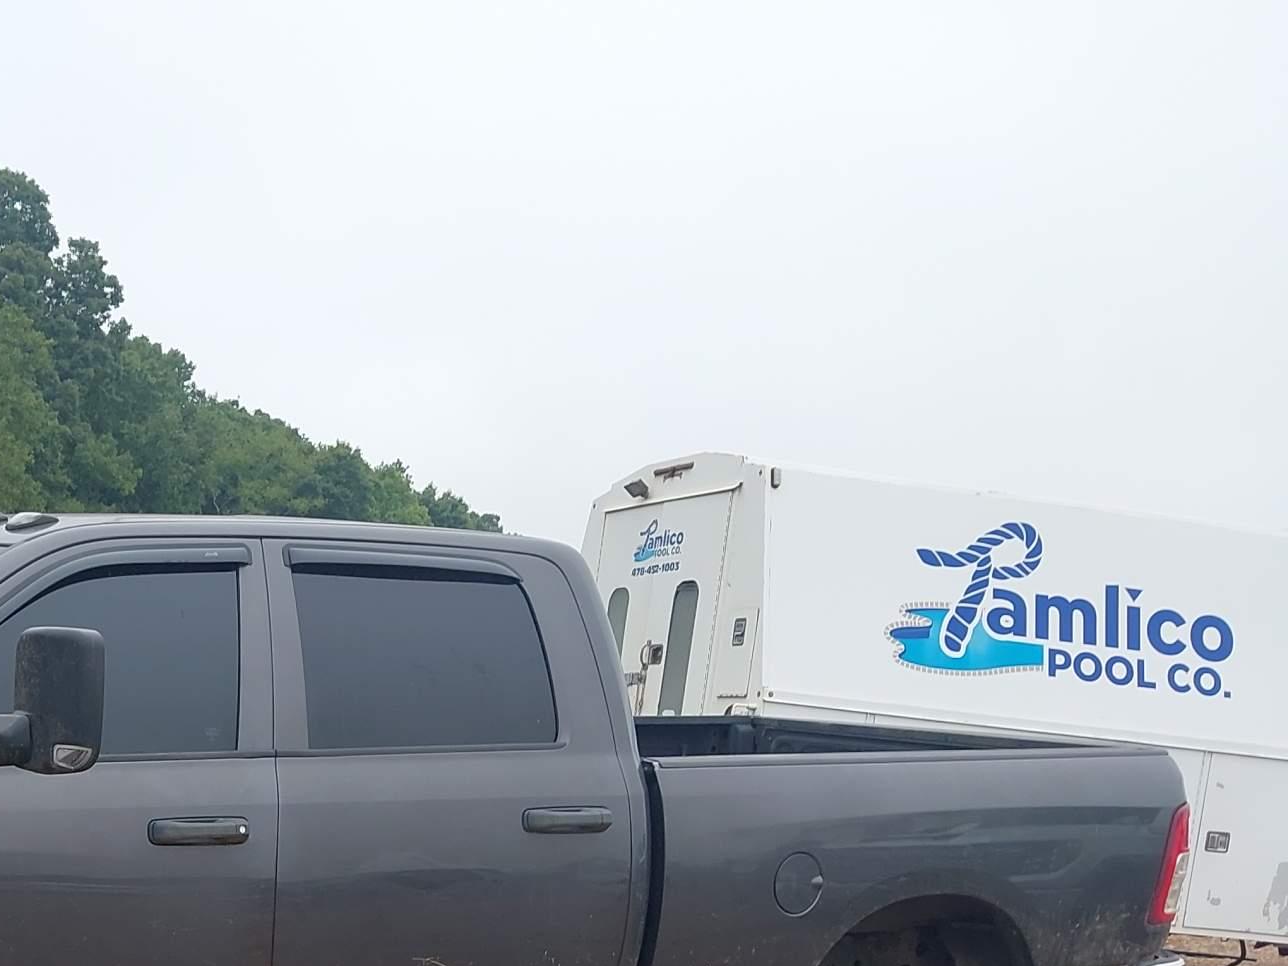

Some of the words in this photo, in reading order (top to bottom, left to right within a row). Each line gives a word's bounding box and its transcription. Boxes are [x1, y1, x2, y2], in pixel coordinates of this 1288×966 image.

[640, 519, 684, 556] Pamlico
[916, 521, 1235, 663] Pamlico
[1047, 647, 1157, 690] POOL
[1167, 662, 1232, 699] CO.
